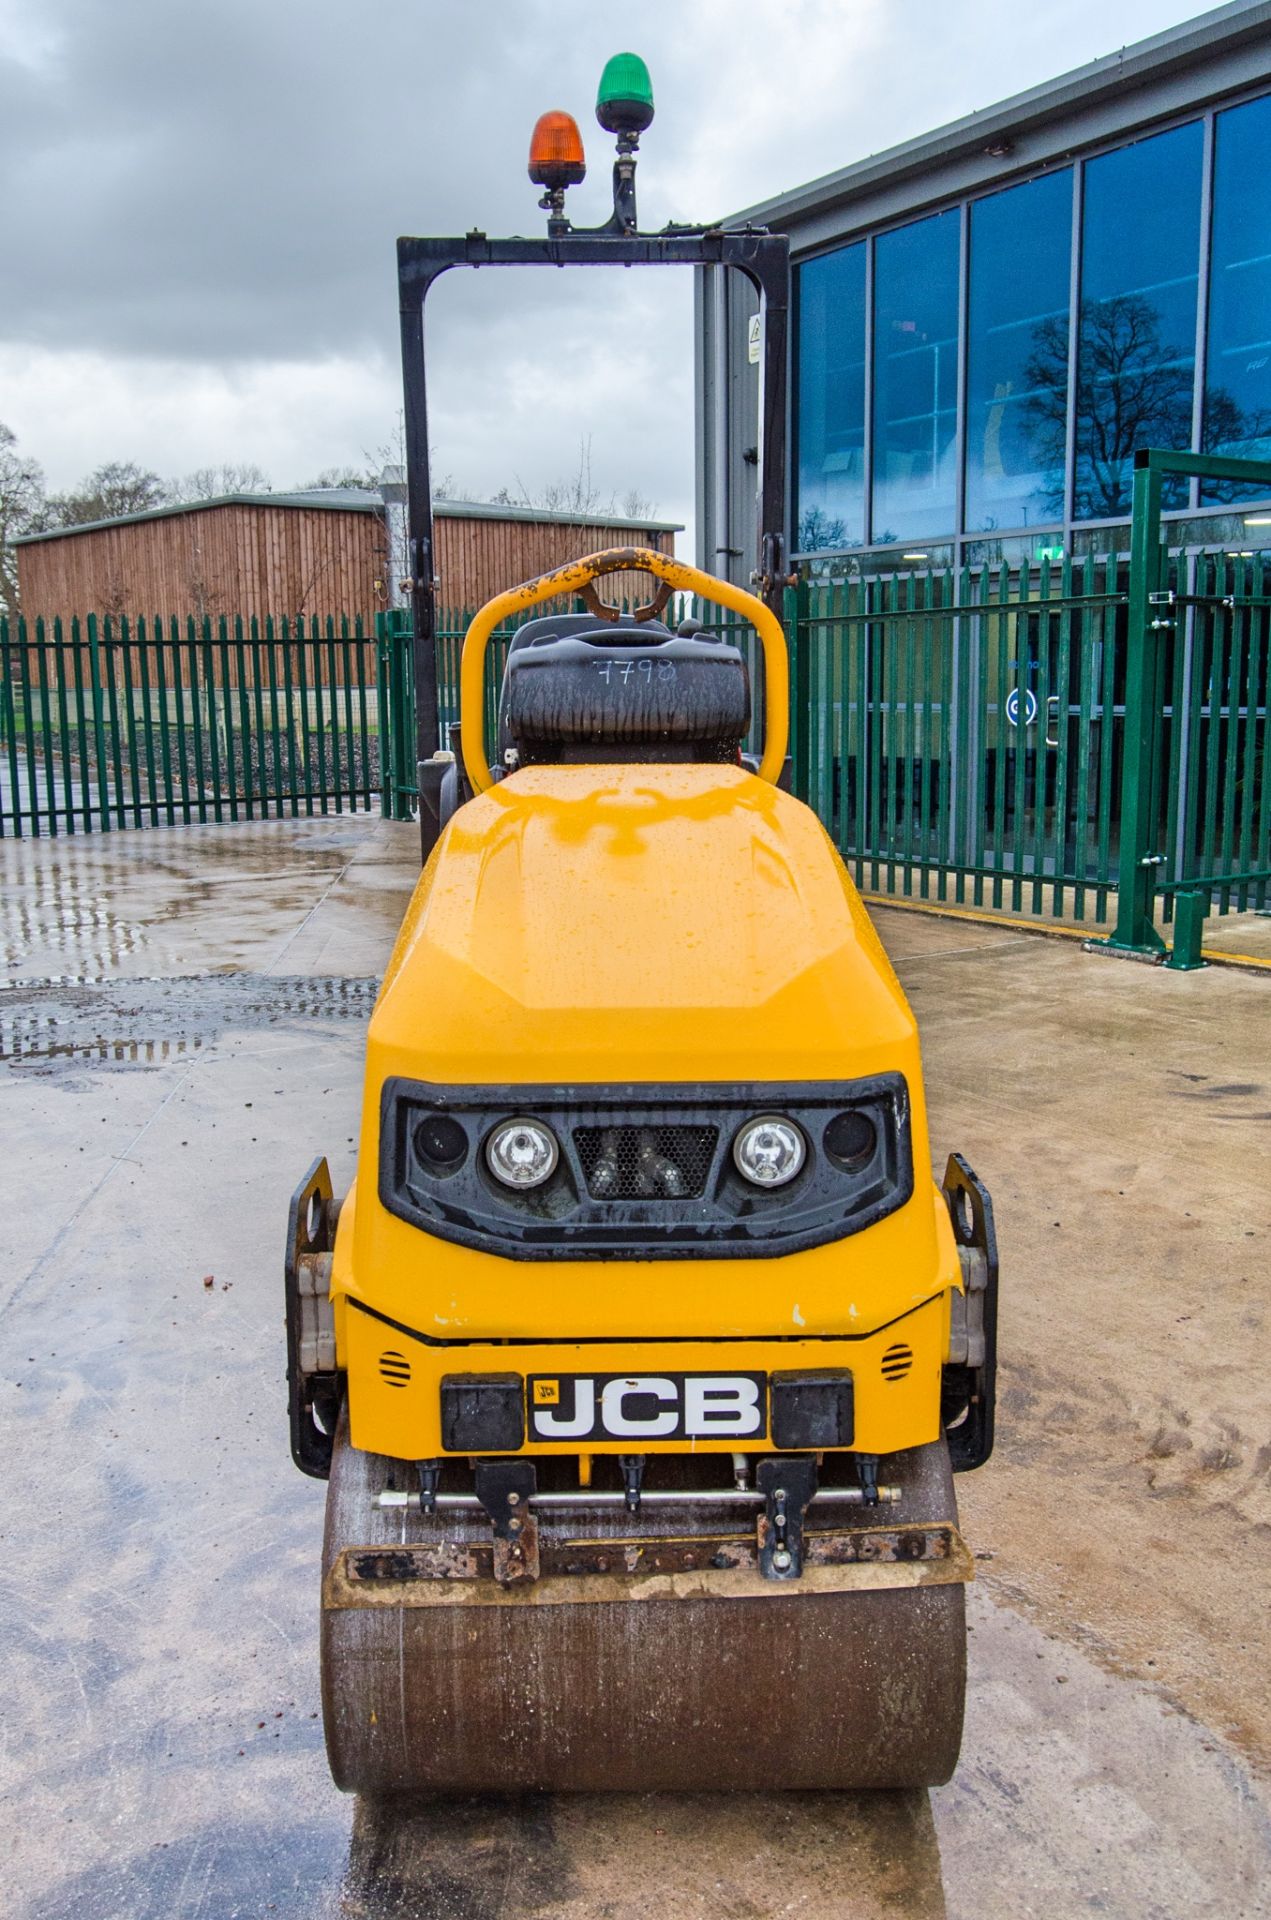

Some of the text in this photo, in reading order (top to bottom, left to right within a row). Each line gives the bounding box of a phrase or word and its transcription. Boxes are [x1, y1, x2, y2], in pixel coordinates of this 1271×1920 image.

[592, 659, 677, 685] 7798
[539, 1385, 556, 1398] JCB
[534, 1377, 761, 1437] JCB
